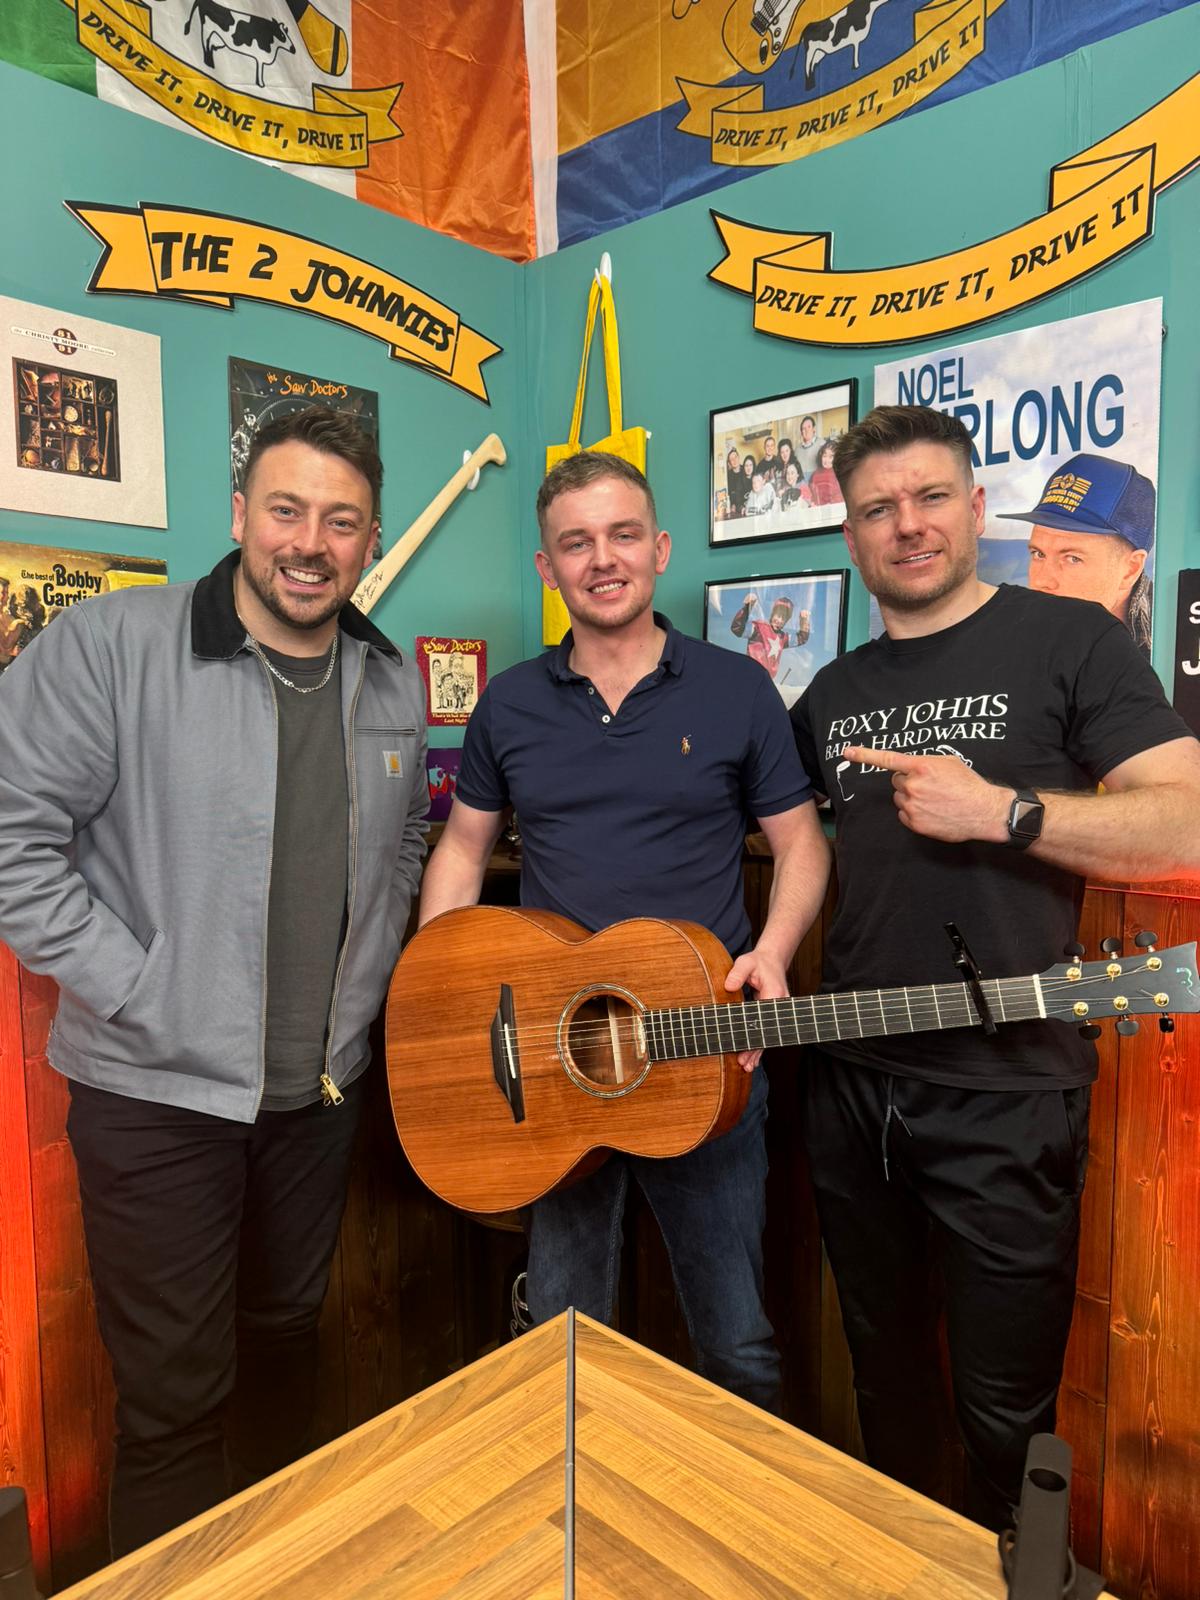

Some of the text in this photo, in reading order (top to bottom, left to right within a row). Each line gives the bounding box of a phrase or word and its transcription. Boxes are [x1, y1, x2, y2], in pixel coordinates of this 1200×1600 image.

[81, 11, 153, 72] DRIVE
[193, 91, 256, 131] DRIVE
[261, 120, 289, 149] IT,
[297, 128, 344, 150] DRIVE
[350, 133, 364, 151] IT
[714, 15, 981, 151] DRIVE IT, DRIVE IT, DRIVE IT
[755, 183, 1145, 328] DRIVE IT, DRIVE IT, DRIVE IT
[151, 231, 455, 352] THE 2 JOHNNIES
[25, 330, 59, 343] CHRISTY
[61, 339, 89, 350] MOORE
[280, 375, 308, 395] Saw
[308, 379, 348, 399] Doctors
[898, 356, 974, 406] NOEL
[942, 374, 1125, 468] RLONG
[21, 563, 102, 593] The best of Bobby
[43, 582, 95, 607] Gardi
[450, 639, 482, 653] Doctors
[827, 708, 897, 741] FOXY
[872, 722, 1007, 751] HARDWARE
